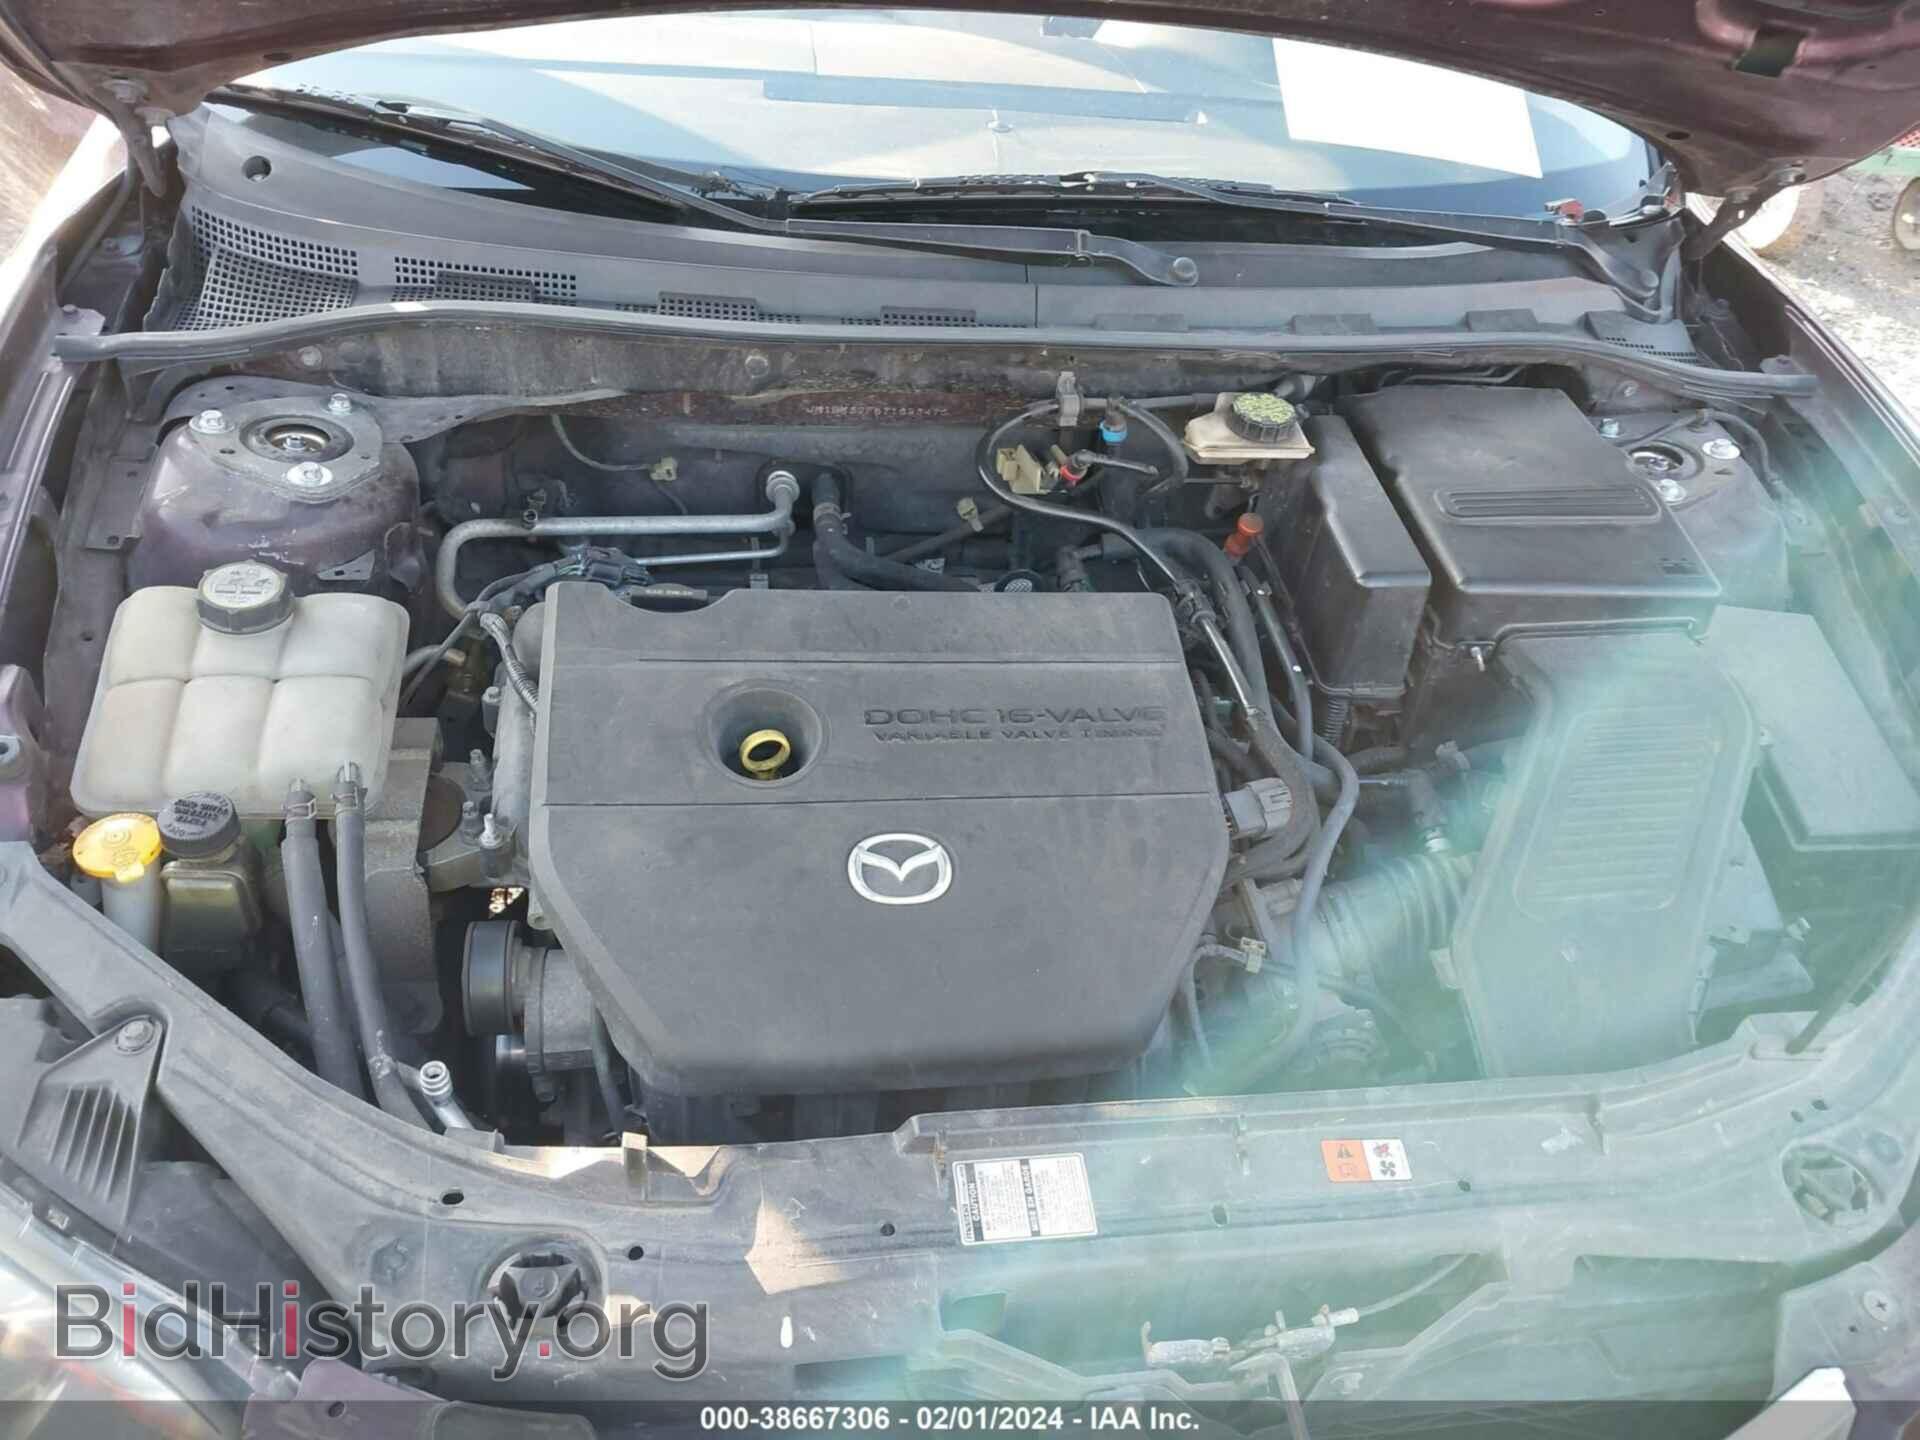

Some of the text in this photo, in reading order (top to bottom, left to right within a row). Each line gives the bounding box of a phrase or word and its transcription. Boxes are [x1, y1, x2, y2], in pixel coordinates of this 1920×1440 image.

[864, 706, 1167, 725] DOHC 16-VALVE
[1001, 729, 1072, 741] VALVE
[967, 1182, 981, 1222] CAUTION
